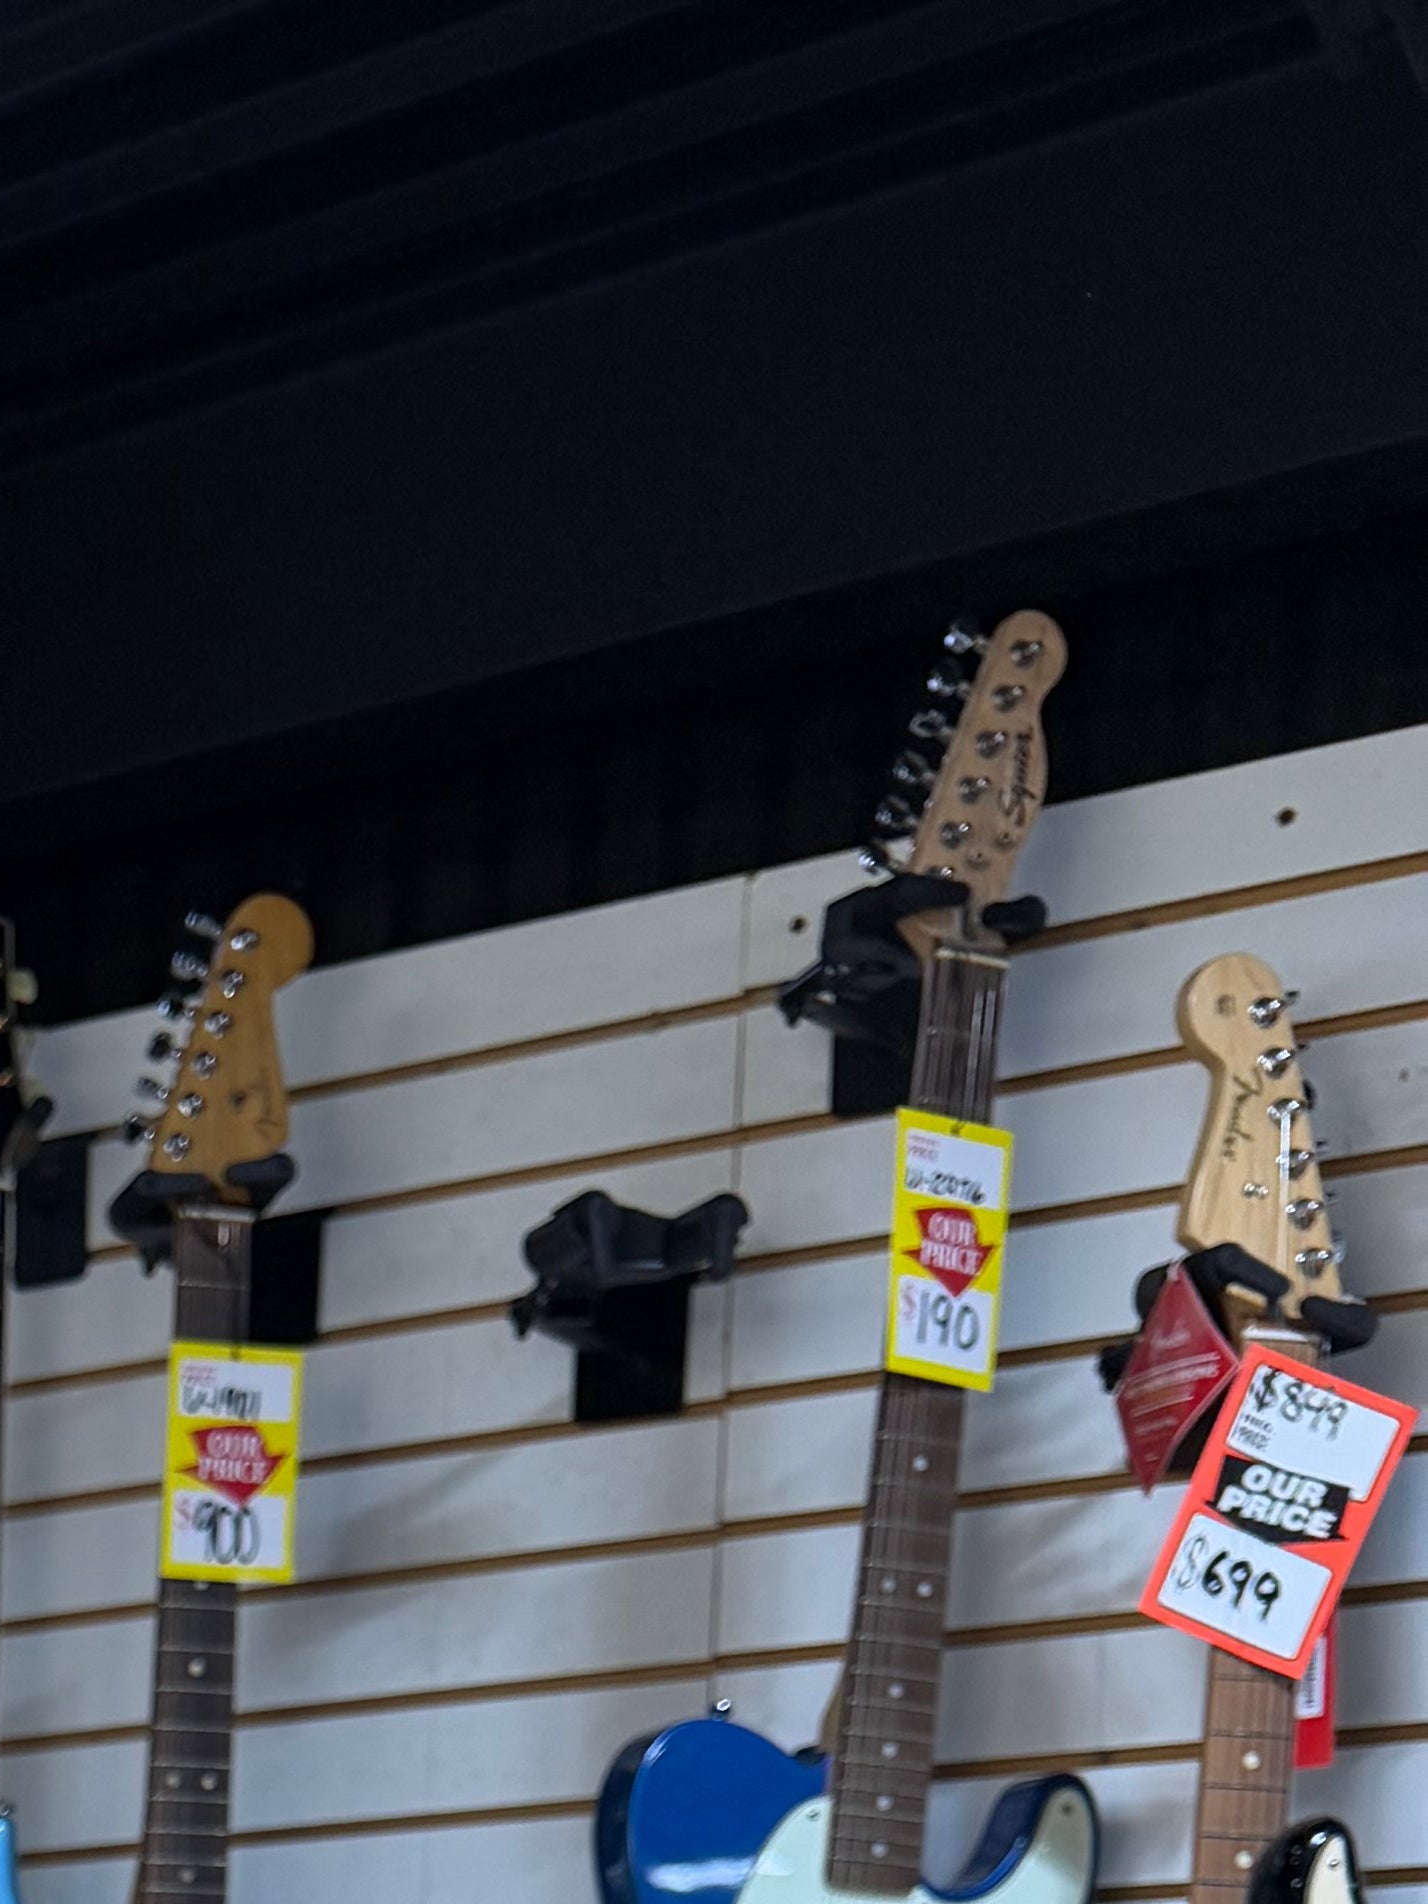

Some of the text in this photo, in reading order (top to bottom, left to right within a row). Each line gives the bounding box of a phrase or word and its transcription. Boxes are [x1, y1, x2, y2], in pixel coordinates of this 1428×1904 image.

[927, 1211, 977, 1247] OUR
[920, 1239, 984, 1276] PRICE
[900, 1278, 980, 1352] $190
[1240, 1463, 1330, 1509] OUR
[1216, 1484, 1341, 1541] PRICE
[1175, 1533, 1282, 1624] $699
